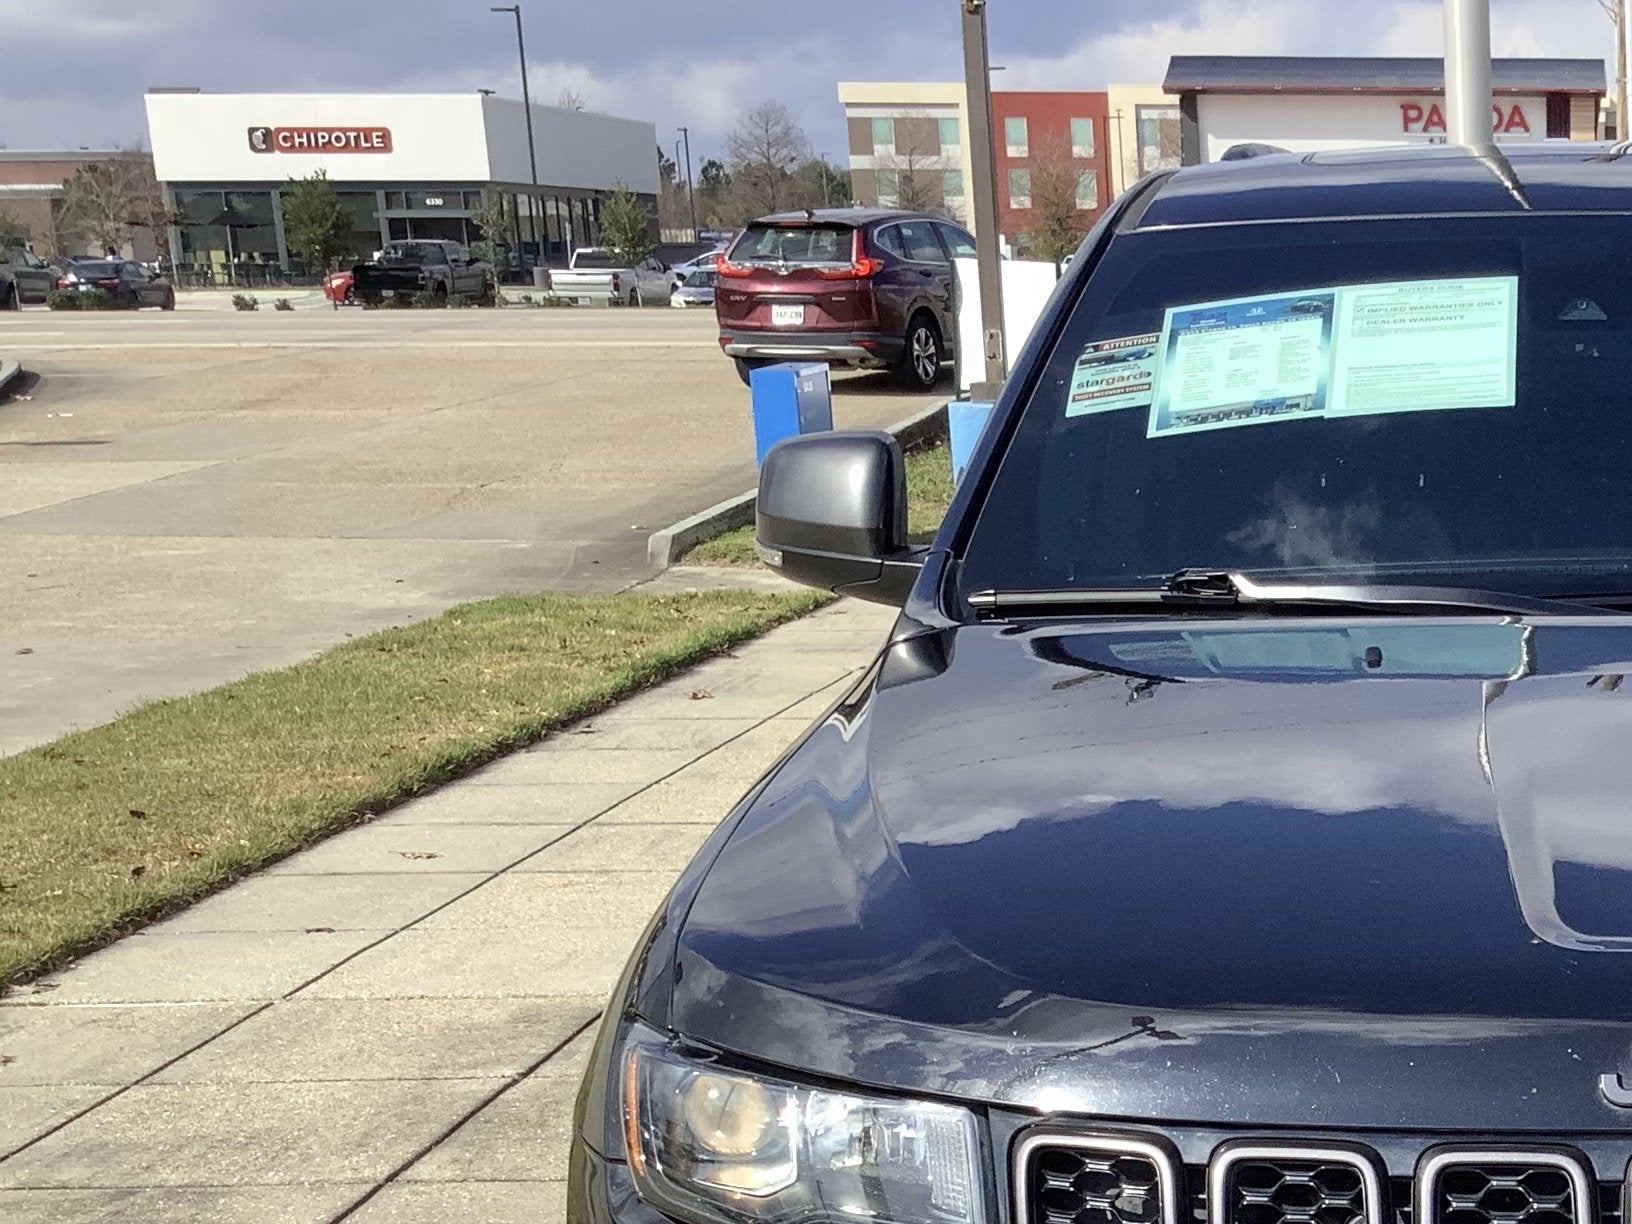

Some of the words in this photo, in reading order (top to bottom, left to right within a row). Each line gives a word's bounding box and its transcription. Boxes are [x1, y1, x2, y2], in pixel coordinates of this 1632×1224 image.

[278, 131, 385, 148] CHIPOTLE
[1408, 302, 1475, 312] WARRANTIES
[1476, 299, 1504, 308] ONLY
[1366, 318, 1407, 326] DEALER
[1408, 314, 1466, 323] WARRANTY
[1103, 336, 1157, 350] ATTENTION
[1076, 371, 1145, 390] stargard
